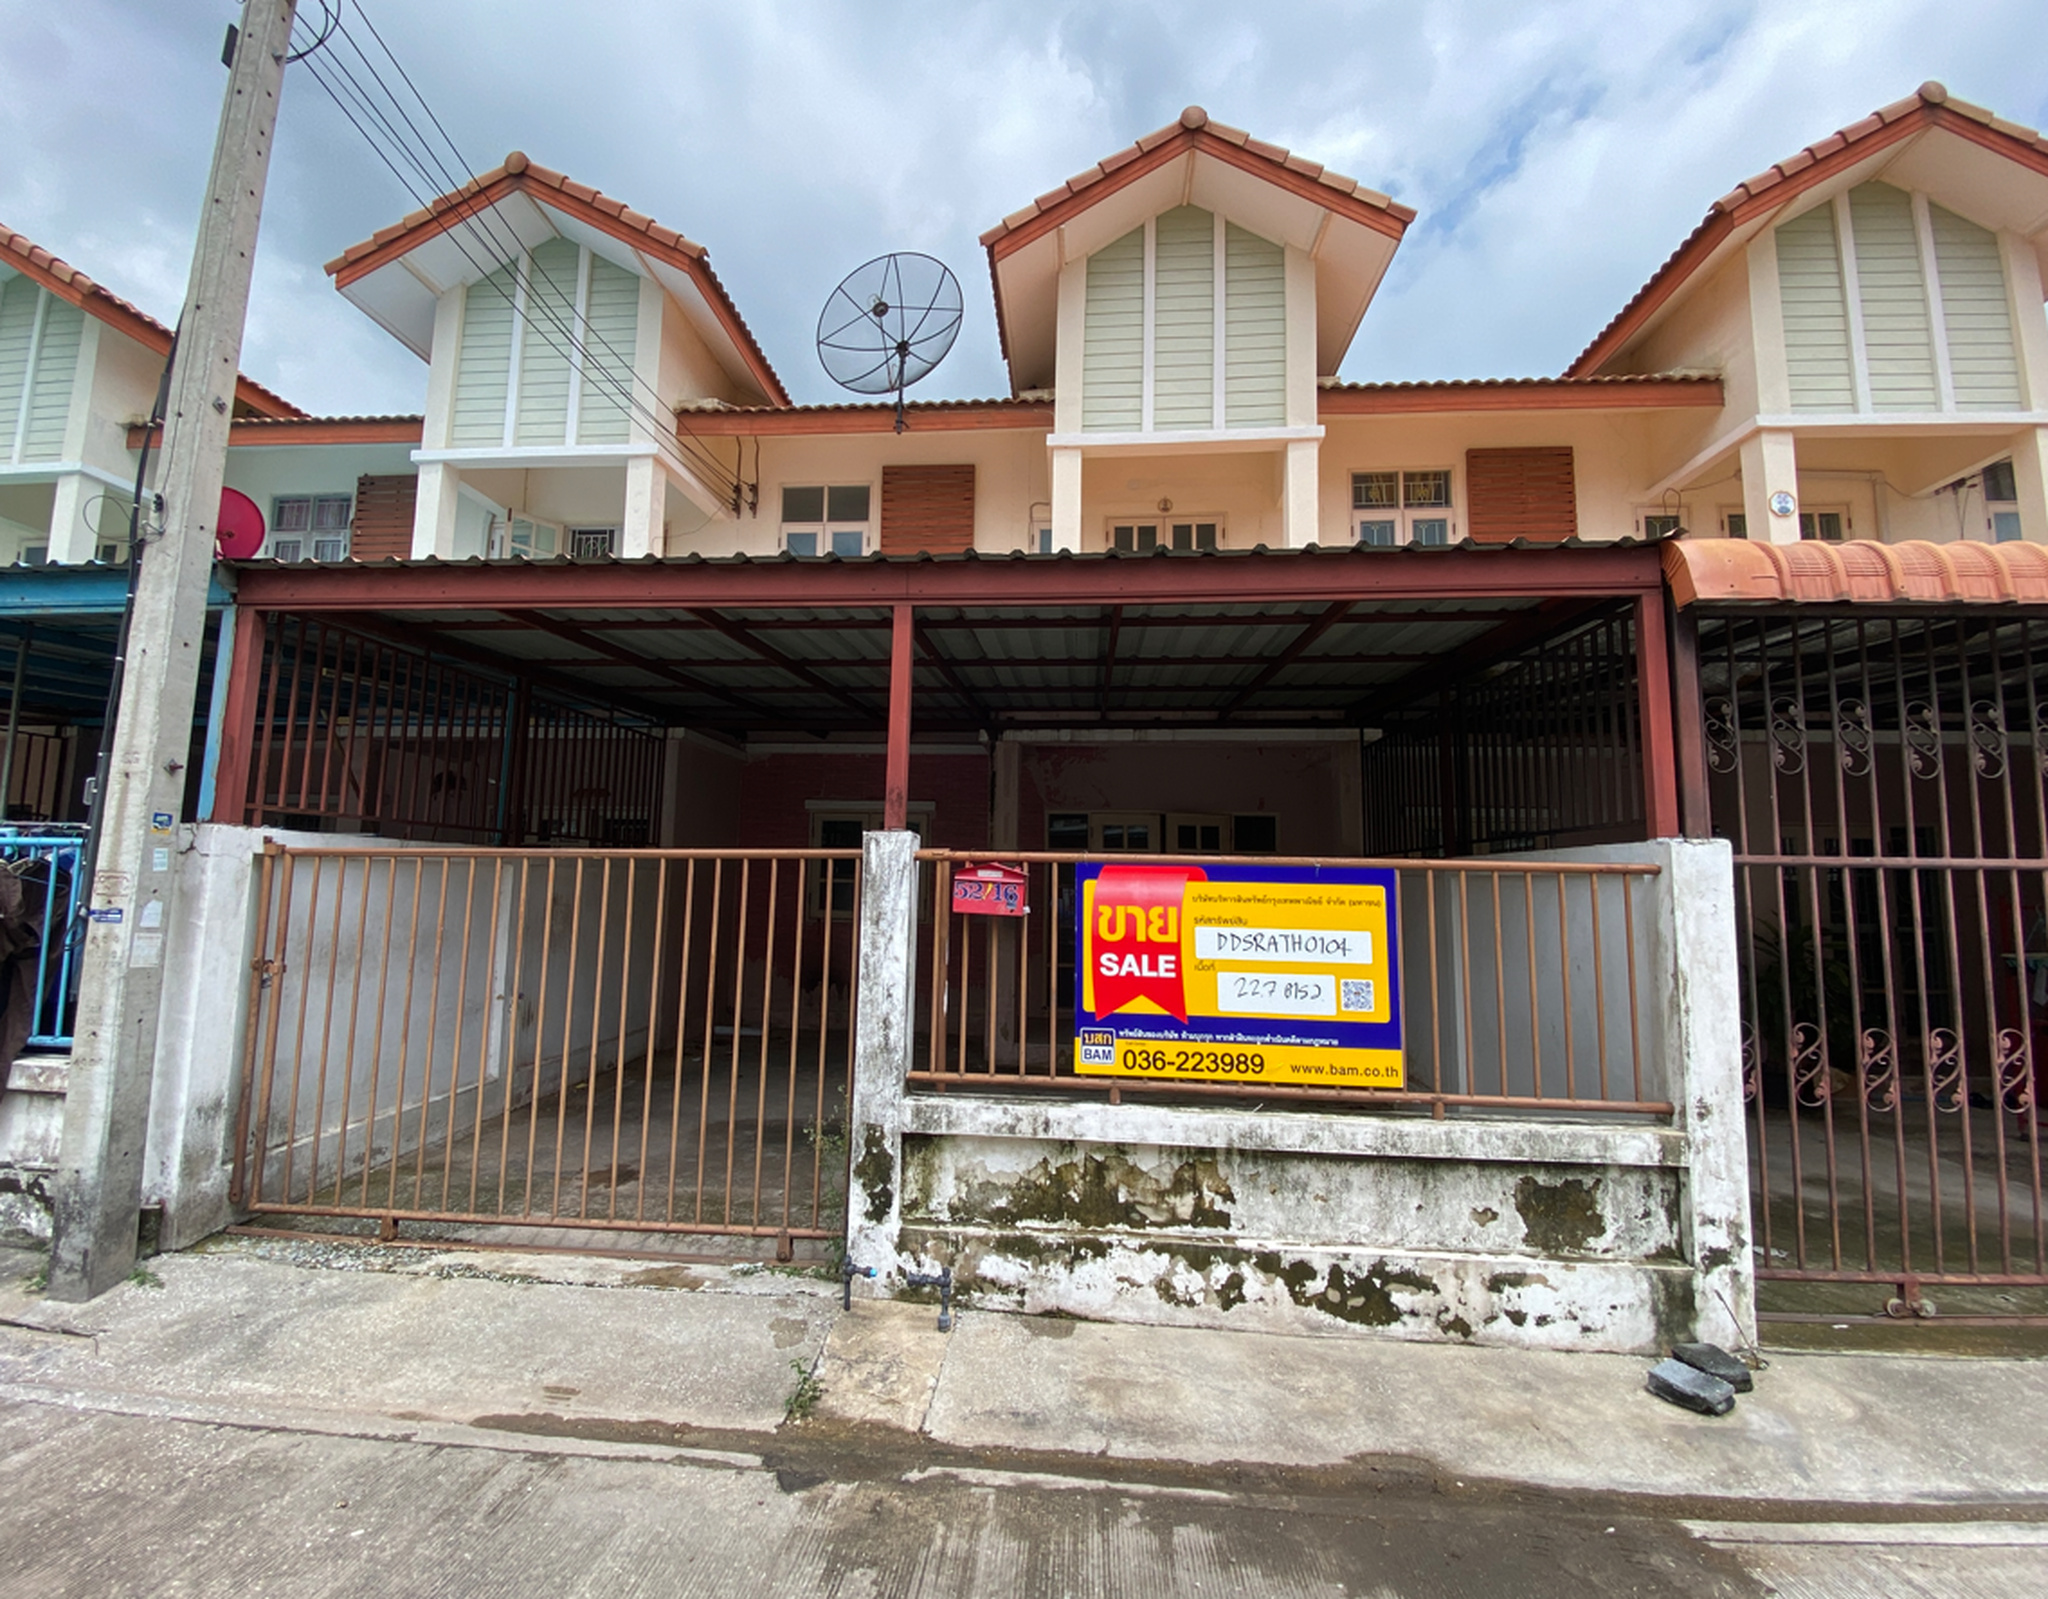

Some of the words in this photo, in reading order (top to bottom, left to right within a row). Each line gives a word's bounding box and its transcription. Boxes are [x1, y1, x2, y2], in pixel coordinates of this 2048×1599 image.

[954, 881, 1018, 902] 52/16
[1098, 904, 1178, 943] ขาย
[1217, 931, 1353, 958] DDSRATH0104
[1100, 952, 1177, 978] SALE
[1084, 1032, 1112, 1045] บสก
[1083, 1048, 1112, 1061] BAM
[1123, 1049, 1265, 1075] 036-223989
[1290, 1062, 1399, 1078] www.bam.co.th
